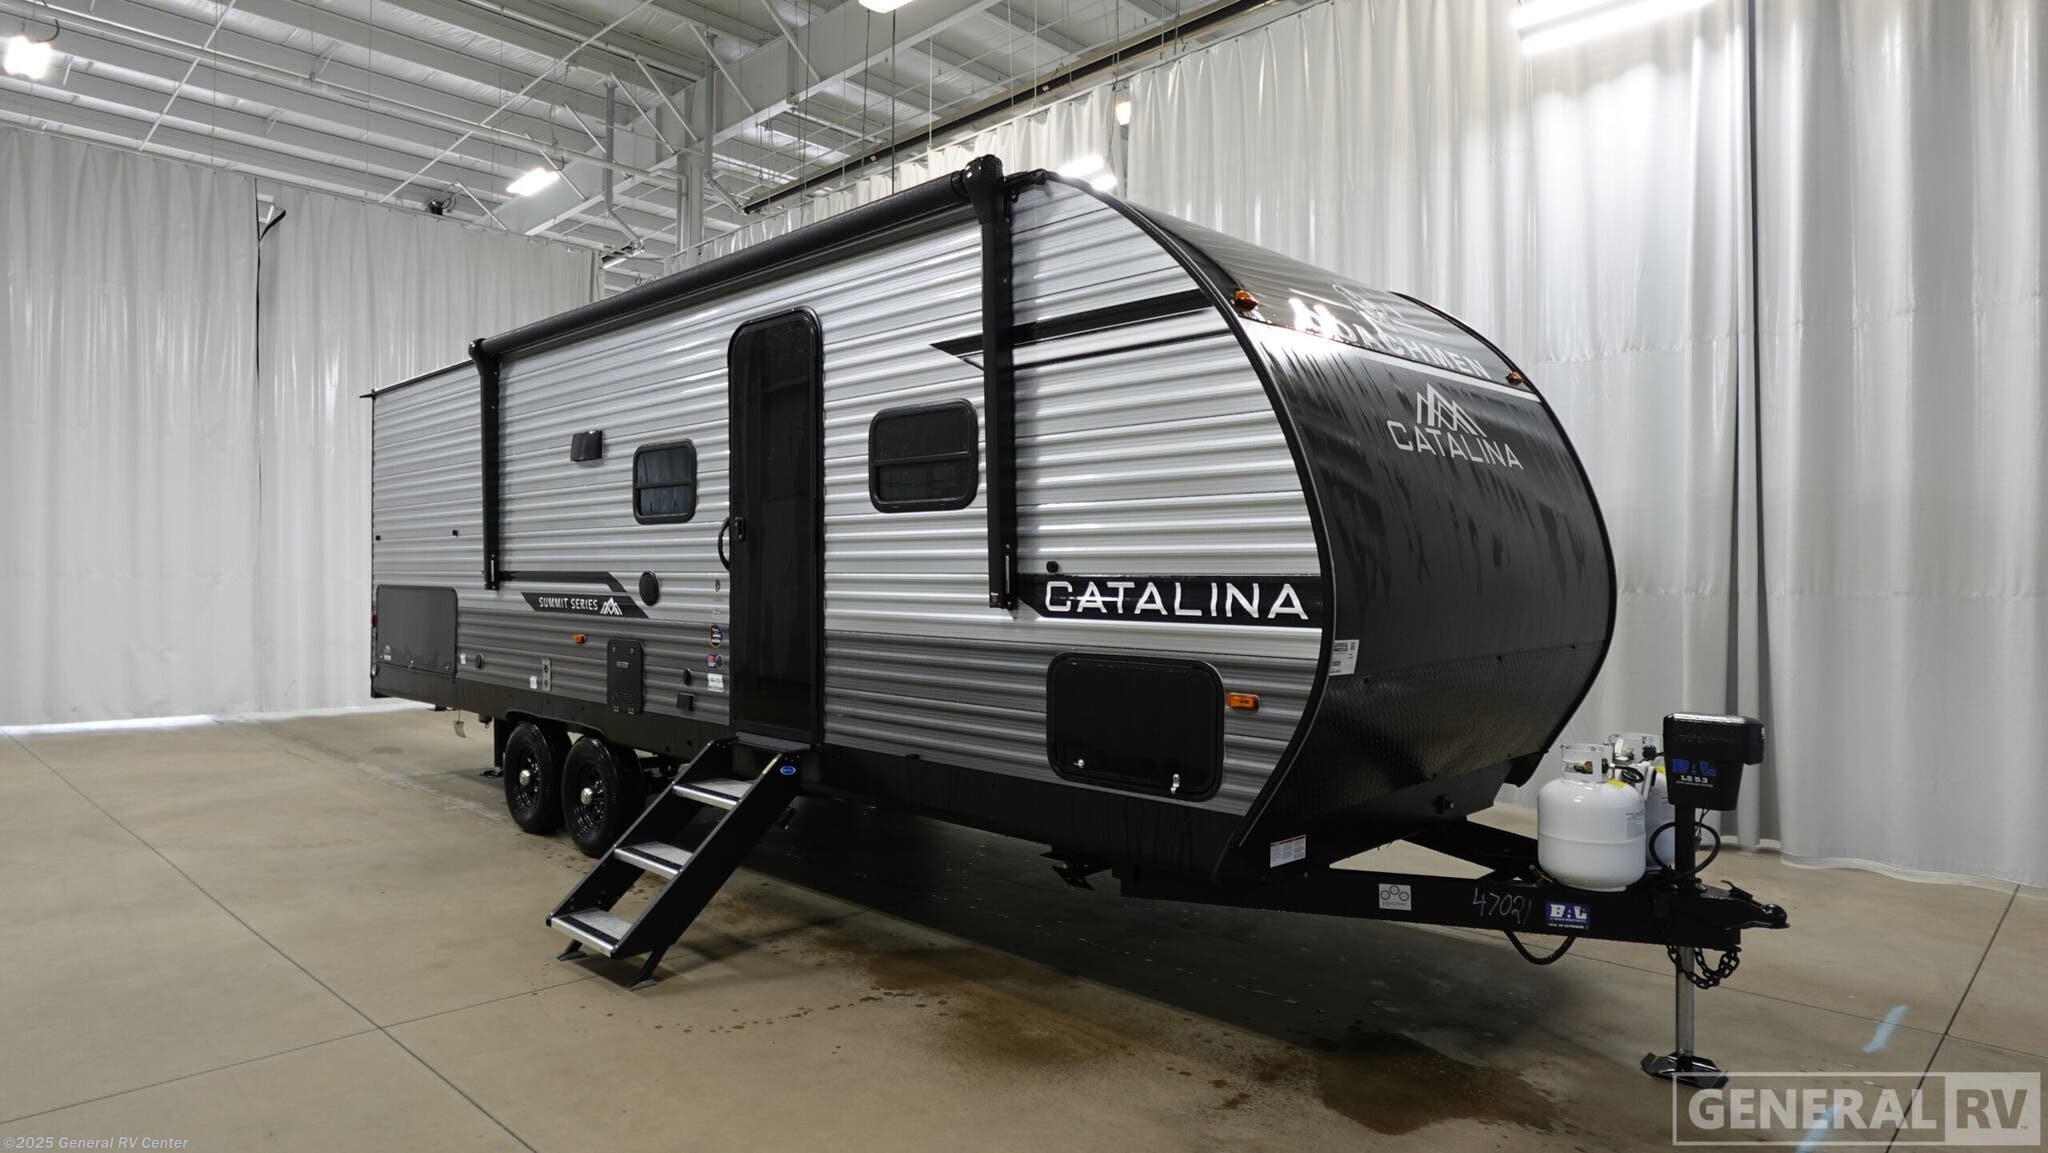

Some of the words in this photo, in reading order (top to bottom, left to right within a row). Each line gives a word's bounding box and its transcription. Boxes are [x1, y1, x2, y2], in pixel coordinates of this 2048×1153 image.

[1288, 297, 1493, 380] OACHMEN
[1387, 419, 1525, 470] CATALINA
[538, 596, 568, 609] SUMMIT
[570, 597, 598, 611] SERIES
[1045, 581, 1309, 620] CATALINA
